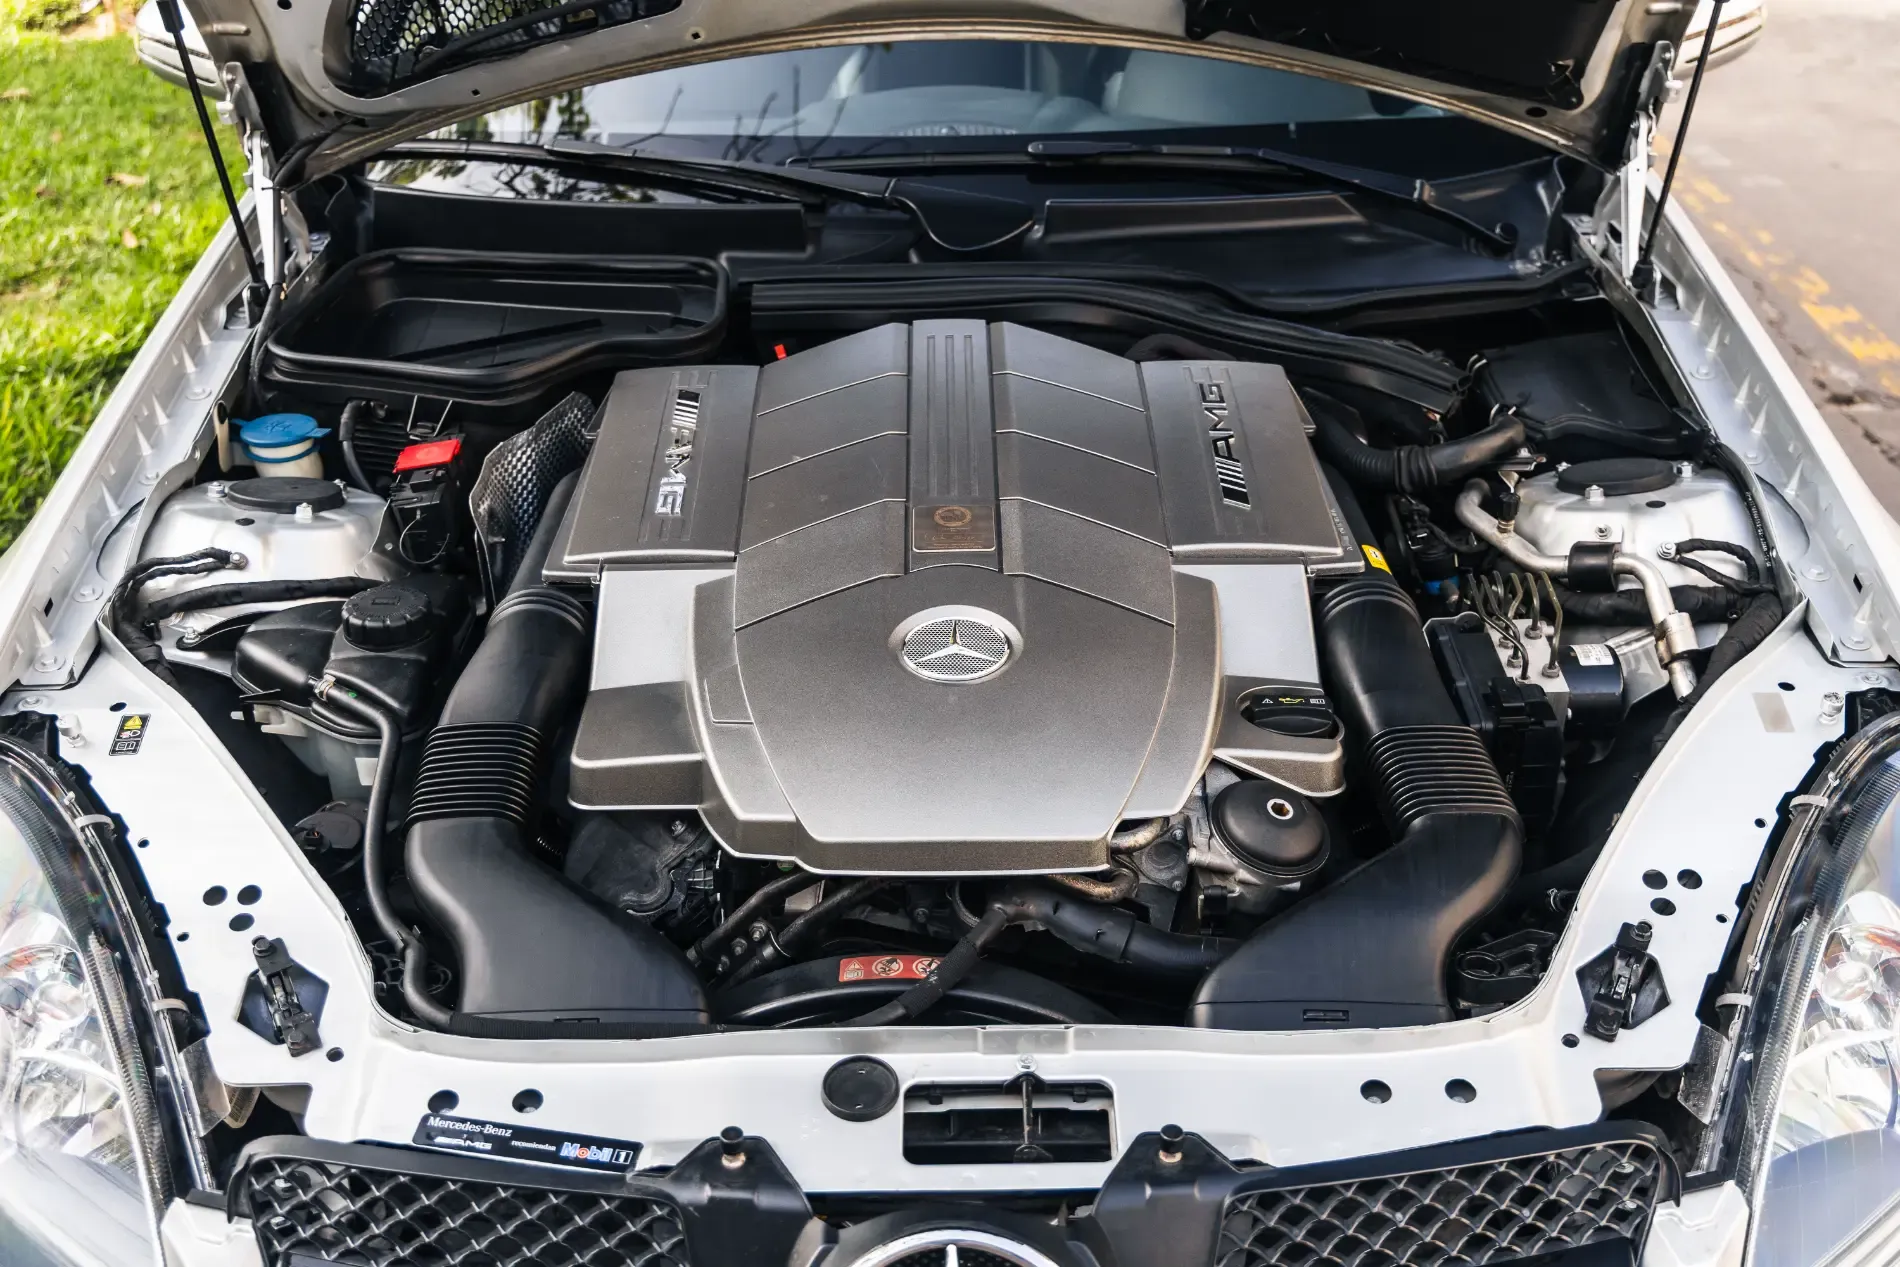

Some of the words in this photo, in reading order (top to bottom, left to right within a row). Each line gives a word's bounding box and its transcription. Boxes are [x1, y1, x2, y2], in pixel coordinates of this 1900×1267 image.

[1199, 383, 1241, 466] AMG
[655, 422, 697, 516] AMG
[427, 1116, 513, 1137] Mercedes-Benz
[560, 1142, 613, 1162] Mobil
